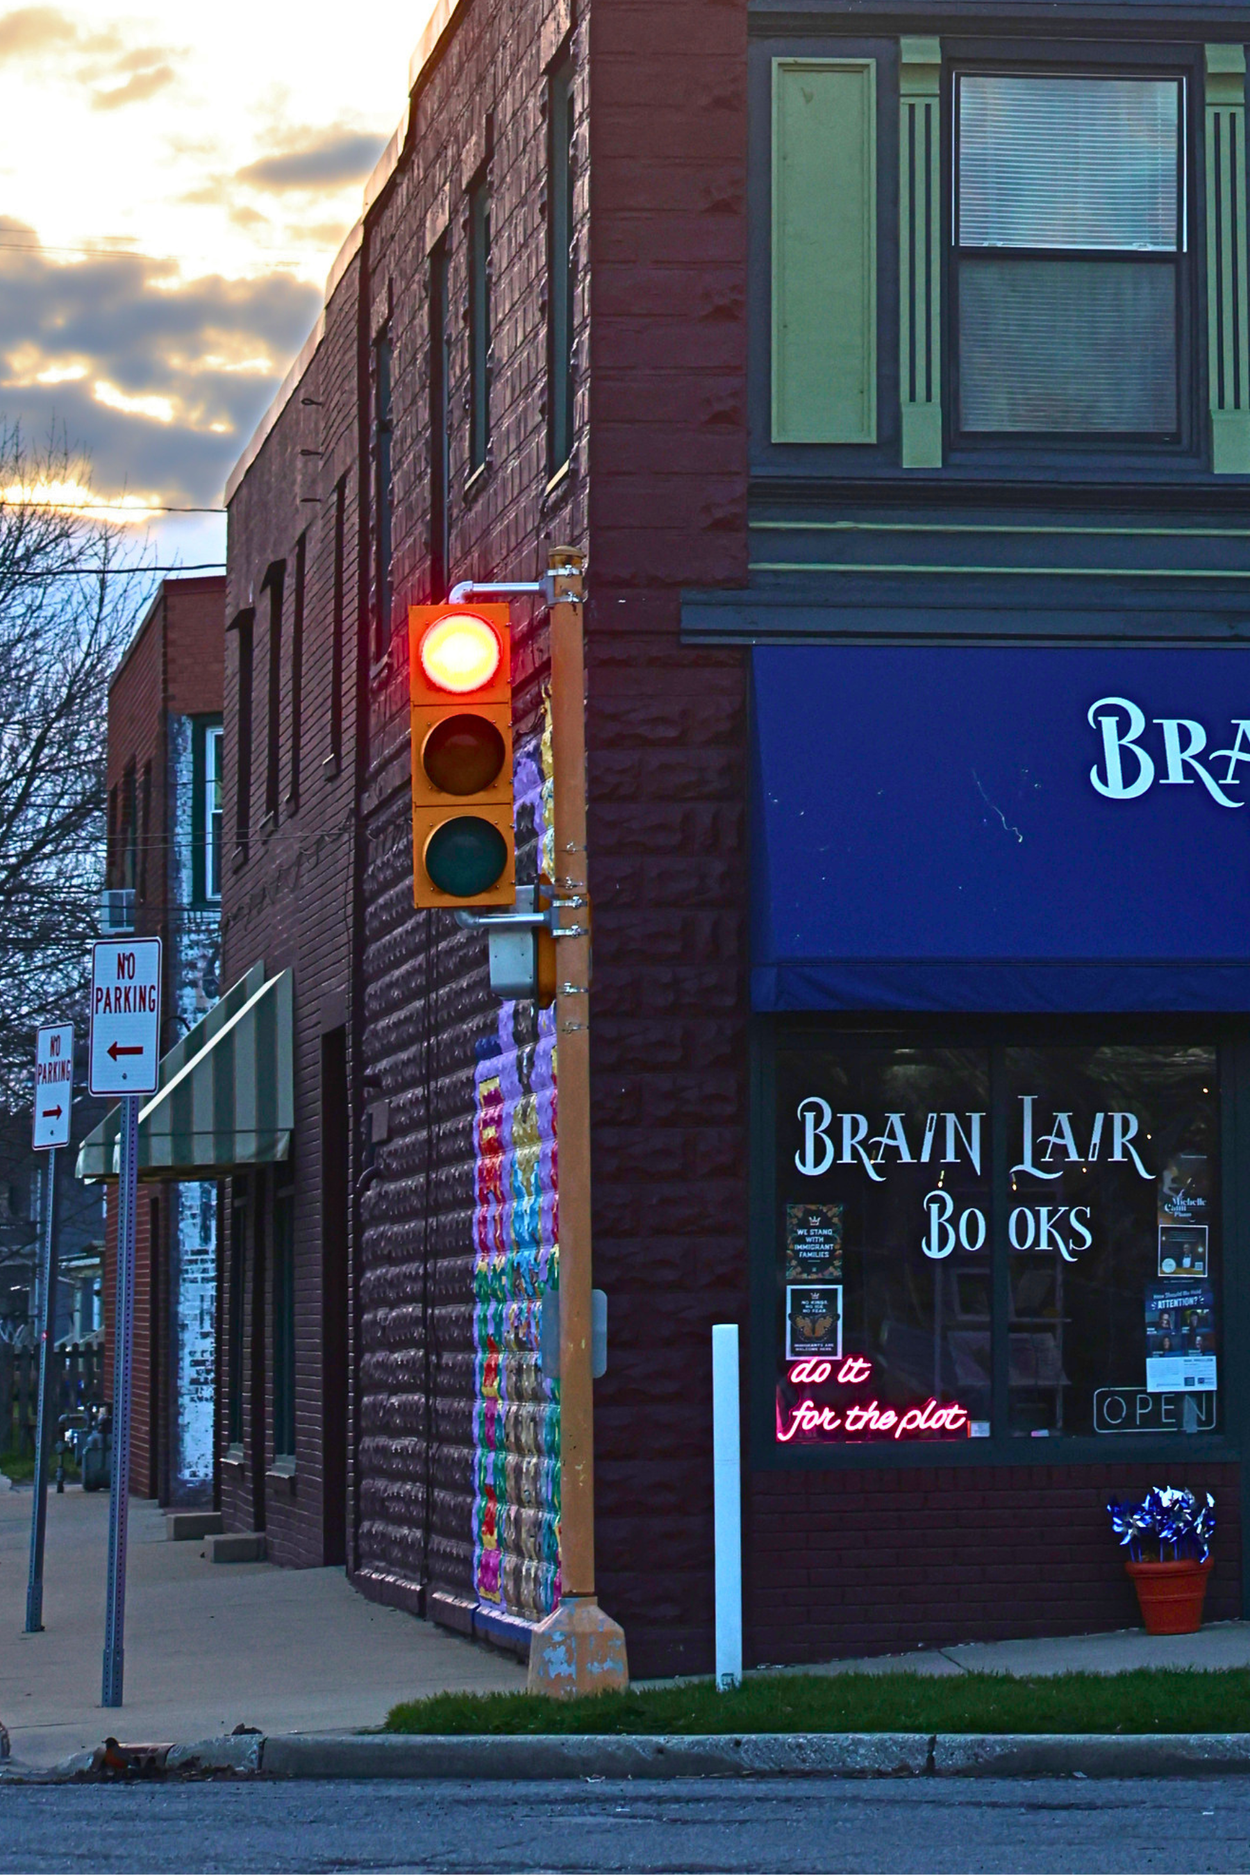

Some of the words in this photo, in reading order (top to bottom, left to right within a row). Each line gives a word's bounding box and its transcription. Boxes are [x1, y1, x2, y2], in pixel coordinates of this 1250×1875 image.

[117, 952, 136, 980] NO
[95, 984, 157, 1015] PARKING
[49, 1035, 61, 1058] NO
[37, 1059, 71, 1085] PARKING
[1157, 1296, 1198, 1309] ATTENTION?
[790, 1357, 832, 1383] do
[837, 1357, 872, 1383] it
[777, 1400, 841, 1441] for
[844, 1400, 898, 1431] the
[895, 1400, 967, 1439] plot
[1103, 1393, 1206, 1425] OPEN
